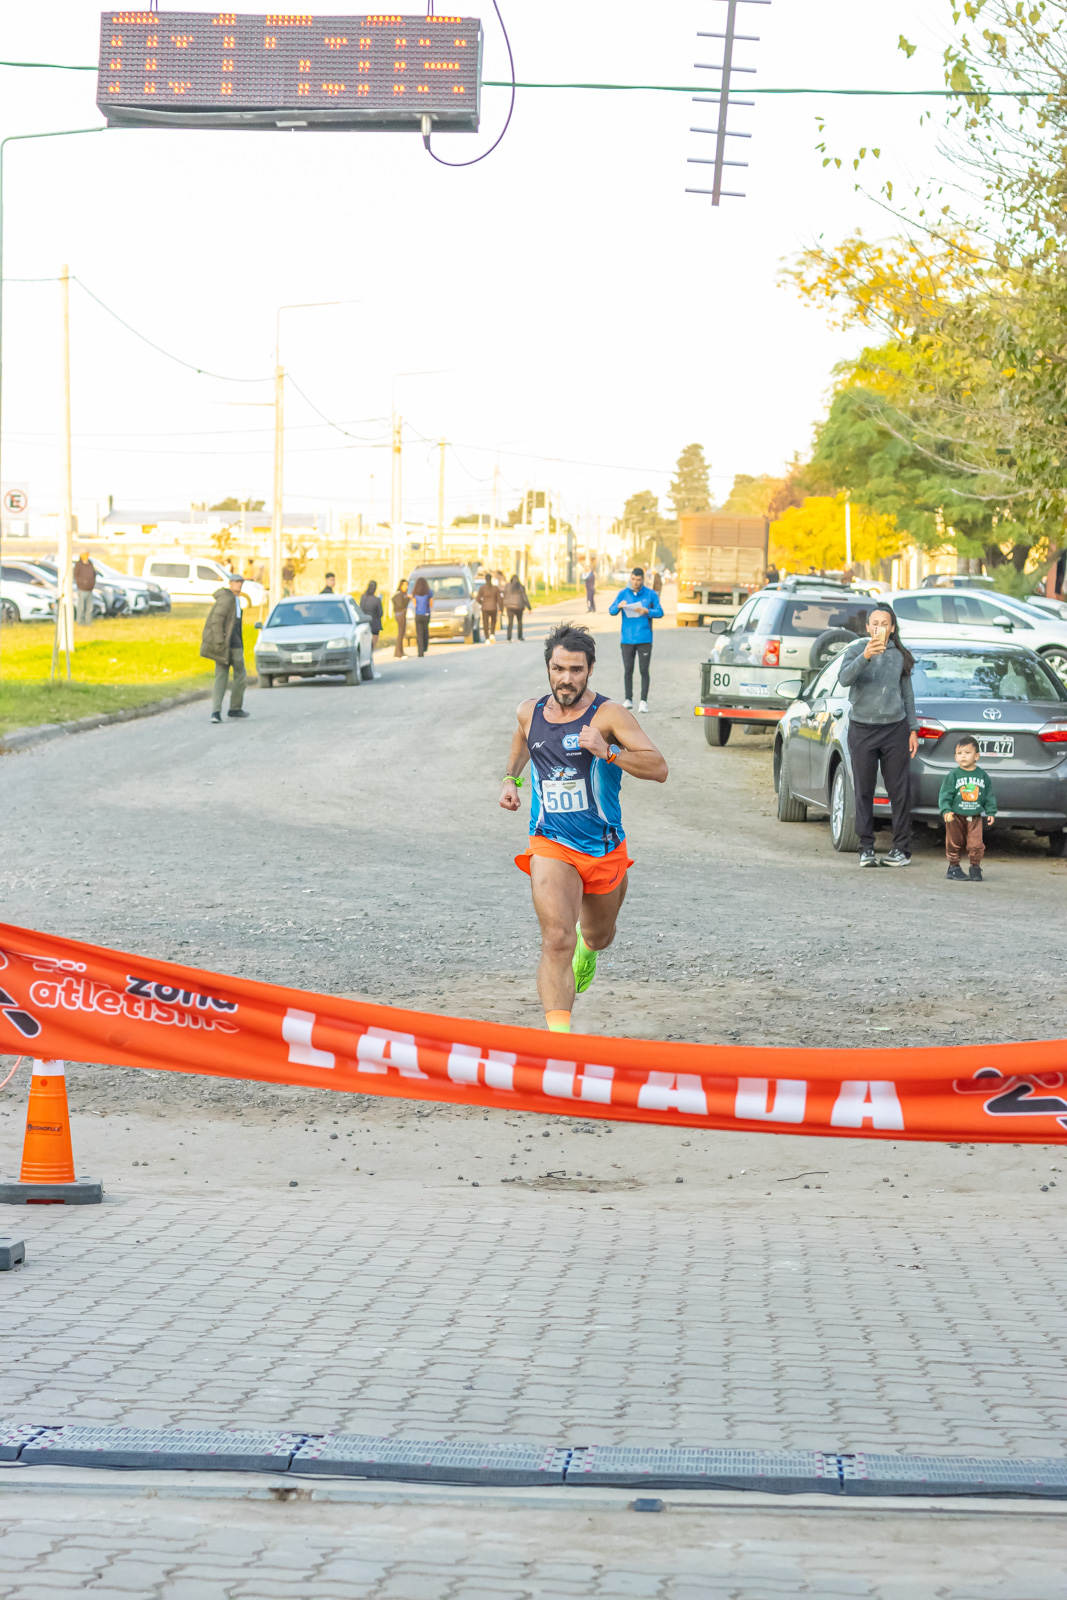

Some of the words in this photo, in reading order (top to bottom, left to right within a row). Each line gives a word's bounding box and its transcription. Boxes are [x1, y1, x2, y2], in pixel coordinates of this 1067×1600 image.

[9, 494, 21, 508] E
[713, 672, 731, 687] 80
[994, 741, 1012, 754] 477
[546, 790, 584, 811] 501
